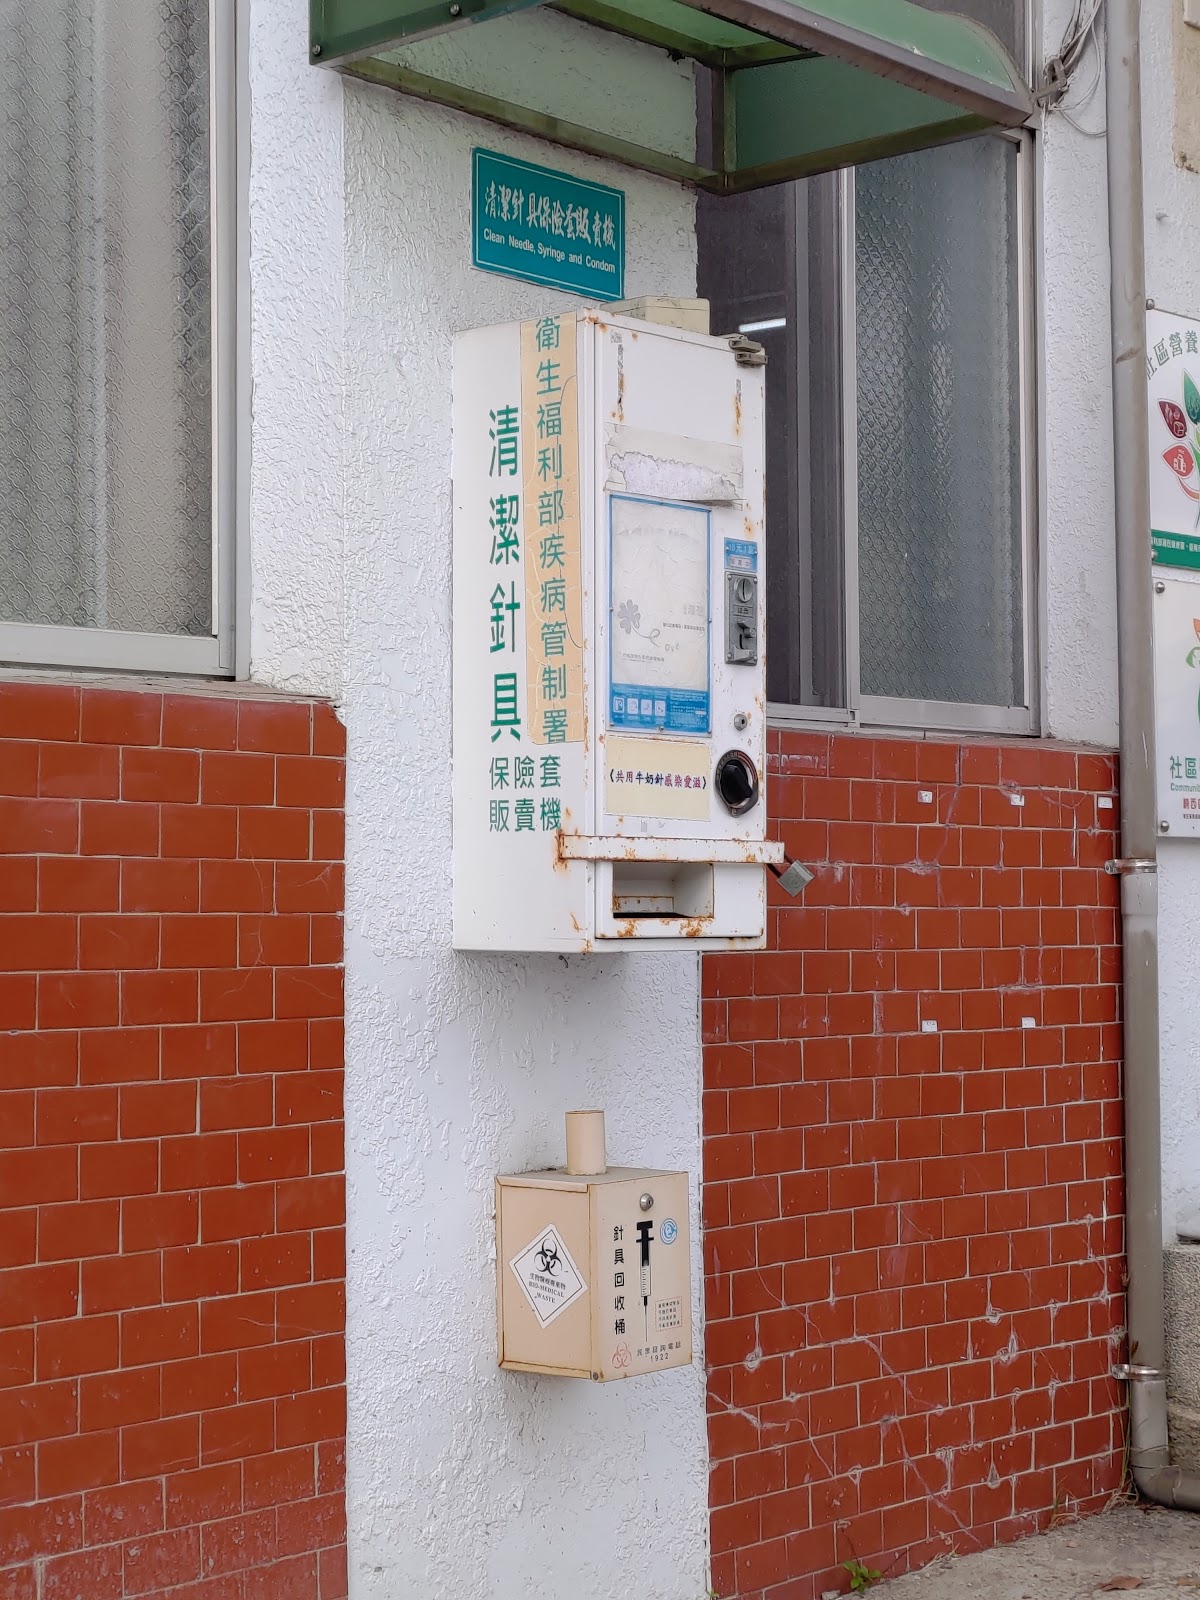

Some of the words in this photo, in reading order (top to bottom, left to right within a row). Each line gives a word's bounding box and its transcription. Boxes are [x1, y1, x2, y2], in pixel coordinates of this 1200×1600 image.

[483, 228, 505, 245] Clean
[508, 234, 536, 255] Needle,
[537, 242, 566, 262] Syringe
[568, 252, 583, 265] and
[585, 256, 616, 274] Condom
[535, 315, 568, 744] 衛生福利部疾病管制署
[489, 404, 522, 743] 清潔針具
[489, 754, 562, 790] 保險套
[489, 797, 562, 833] 販賣機
[528, 1281, 565, 1298] BIO-MEDICAL
[537, 1292, 556, 1304] WASTE
[613, 1225, 626, 1336] 針具回收桶
[650, 1352, 669, 1362] 1922
